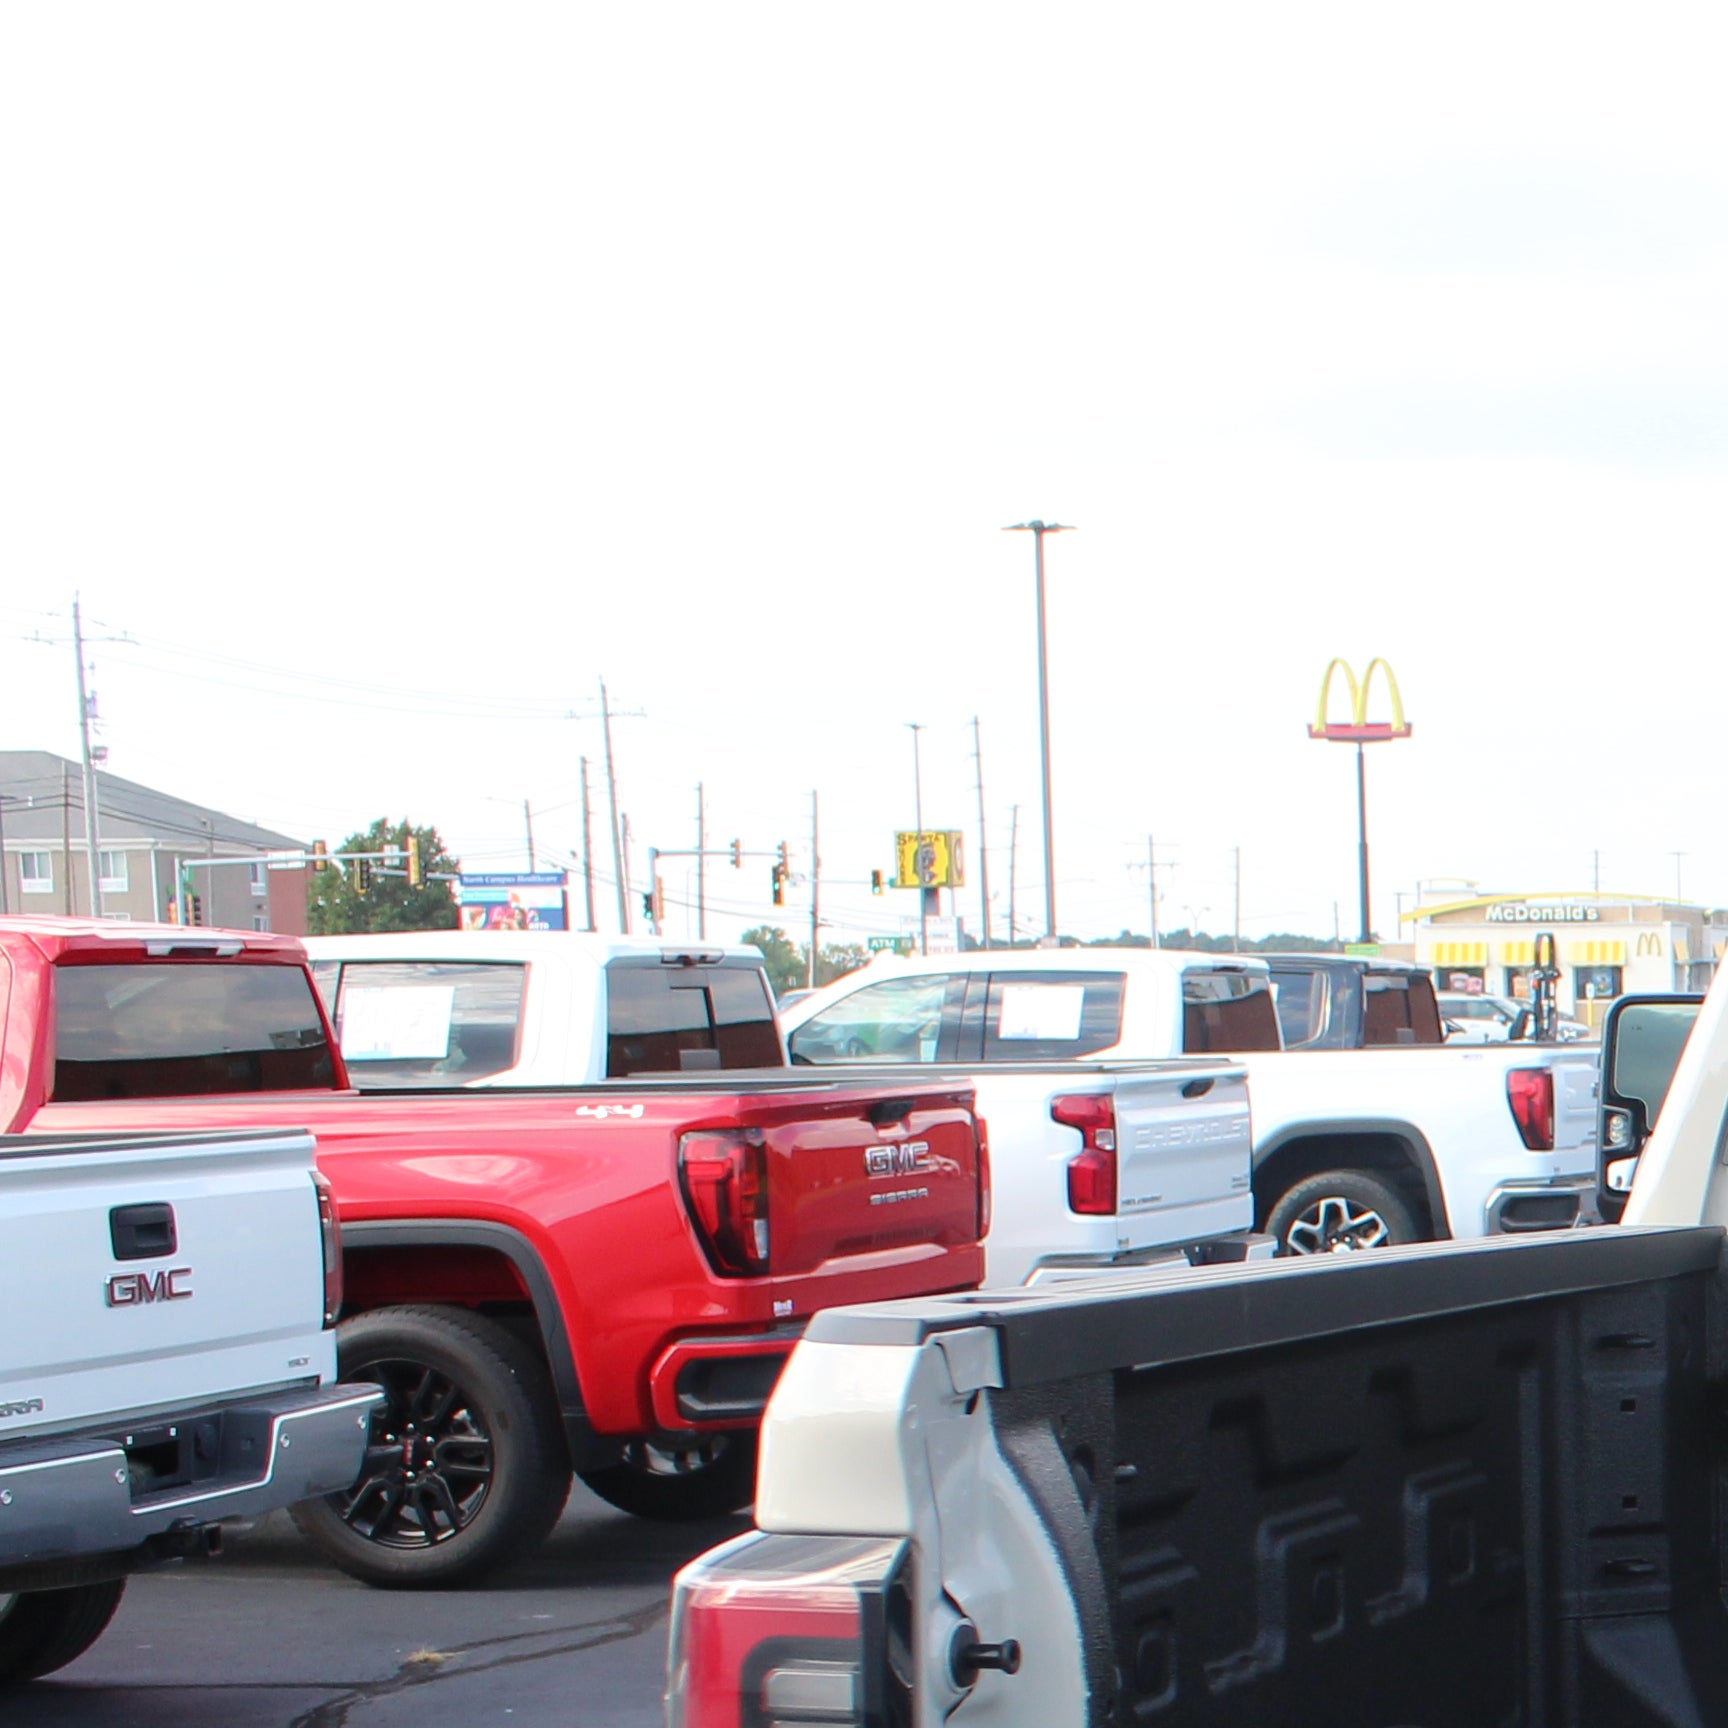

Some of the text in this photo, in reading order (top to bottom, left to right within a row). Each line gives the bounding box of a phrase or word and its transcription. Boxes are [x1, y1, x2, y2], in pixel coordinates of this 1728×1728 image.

[1485, 904, 1599, 922] McDonald's
[871, 938, 895, 948] ATM
[865, 1141, 929, 1175] GMC
[104, 1266, 193, 1308] GMC
